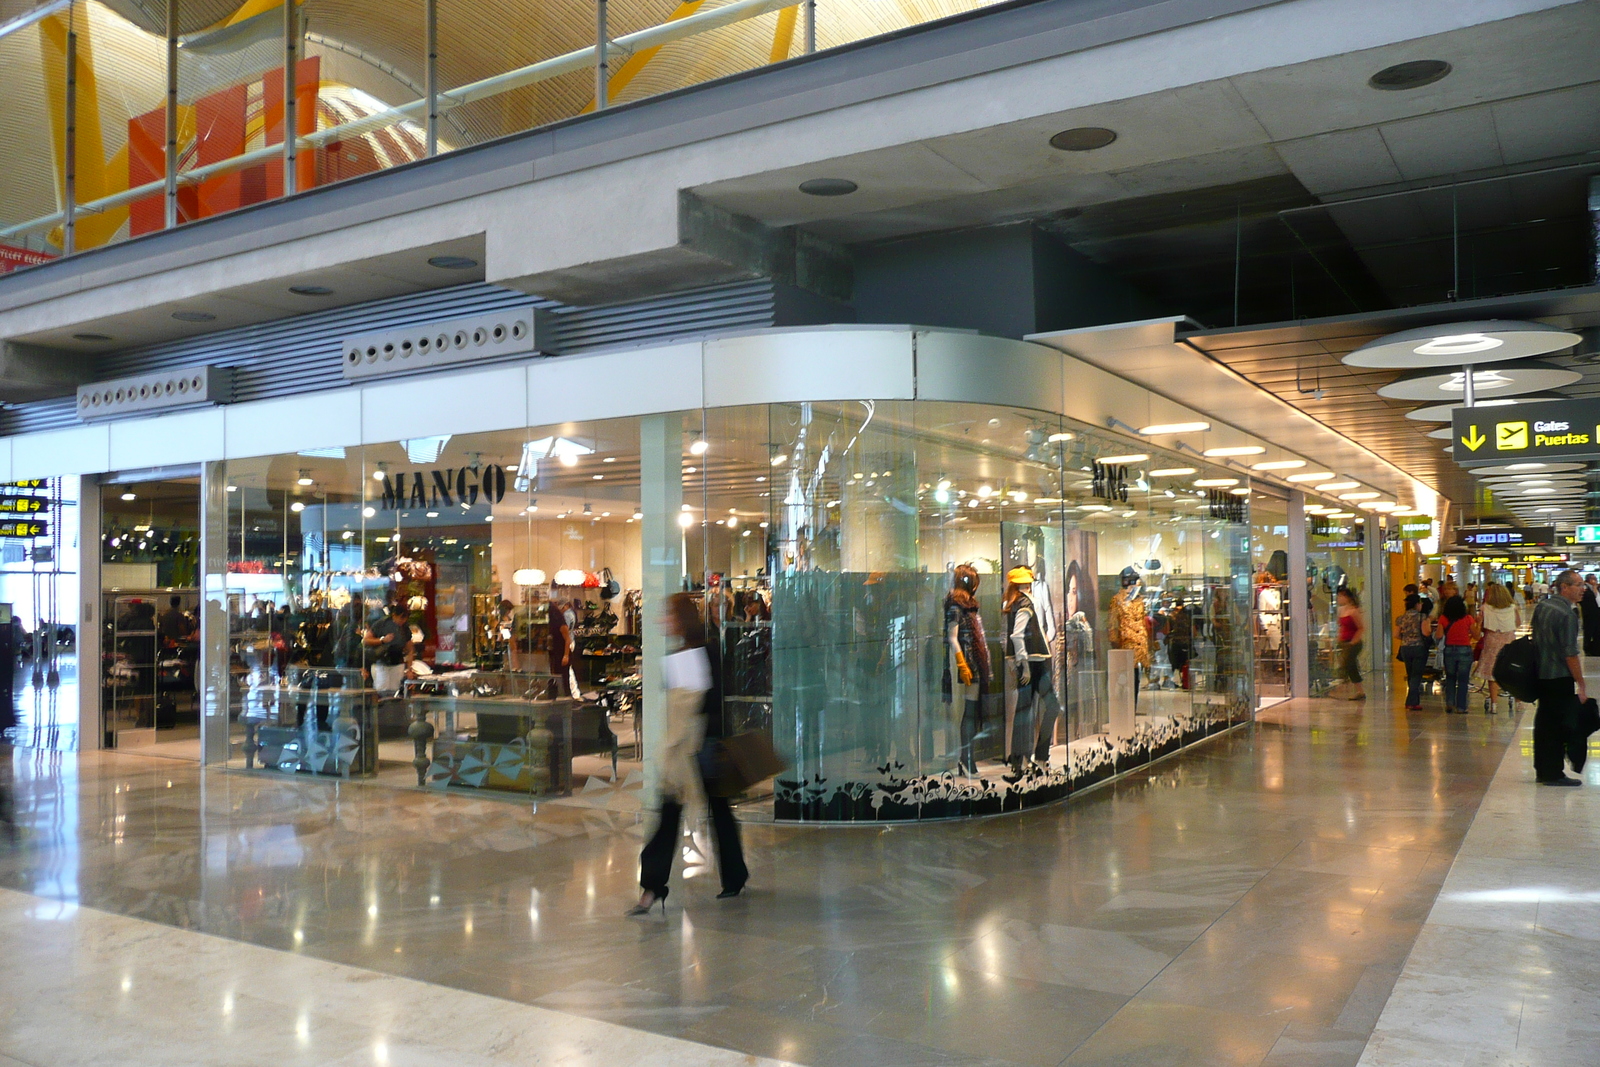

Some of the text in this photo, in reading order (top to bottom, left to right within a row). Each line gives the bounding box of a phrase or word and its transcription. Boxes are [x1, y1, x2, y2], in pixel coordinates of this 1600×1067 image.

[1533, 420, 1569, 433] Gates
[1534, 433, 1590, 447] Puertas
[380, 463, 506, 511] MANGO
